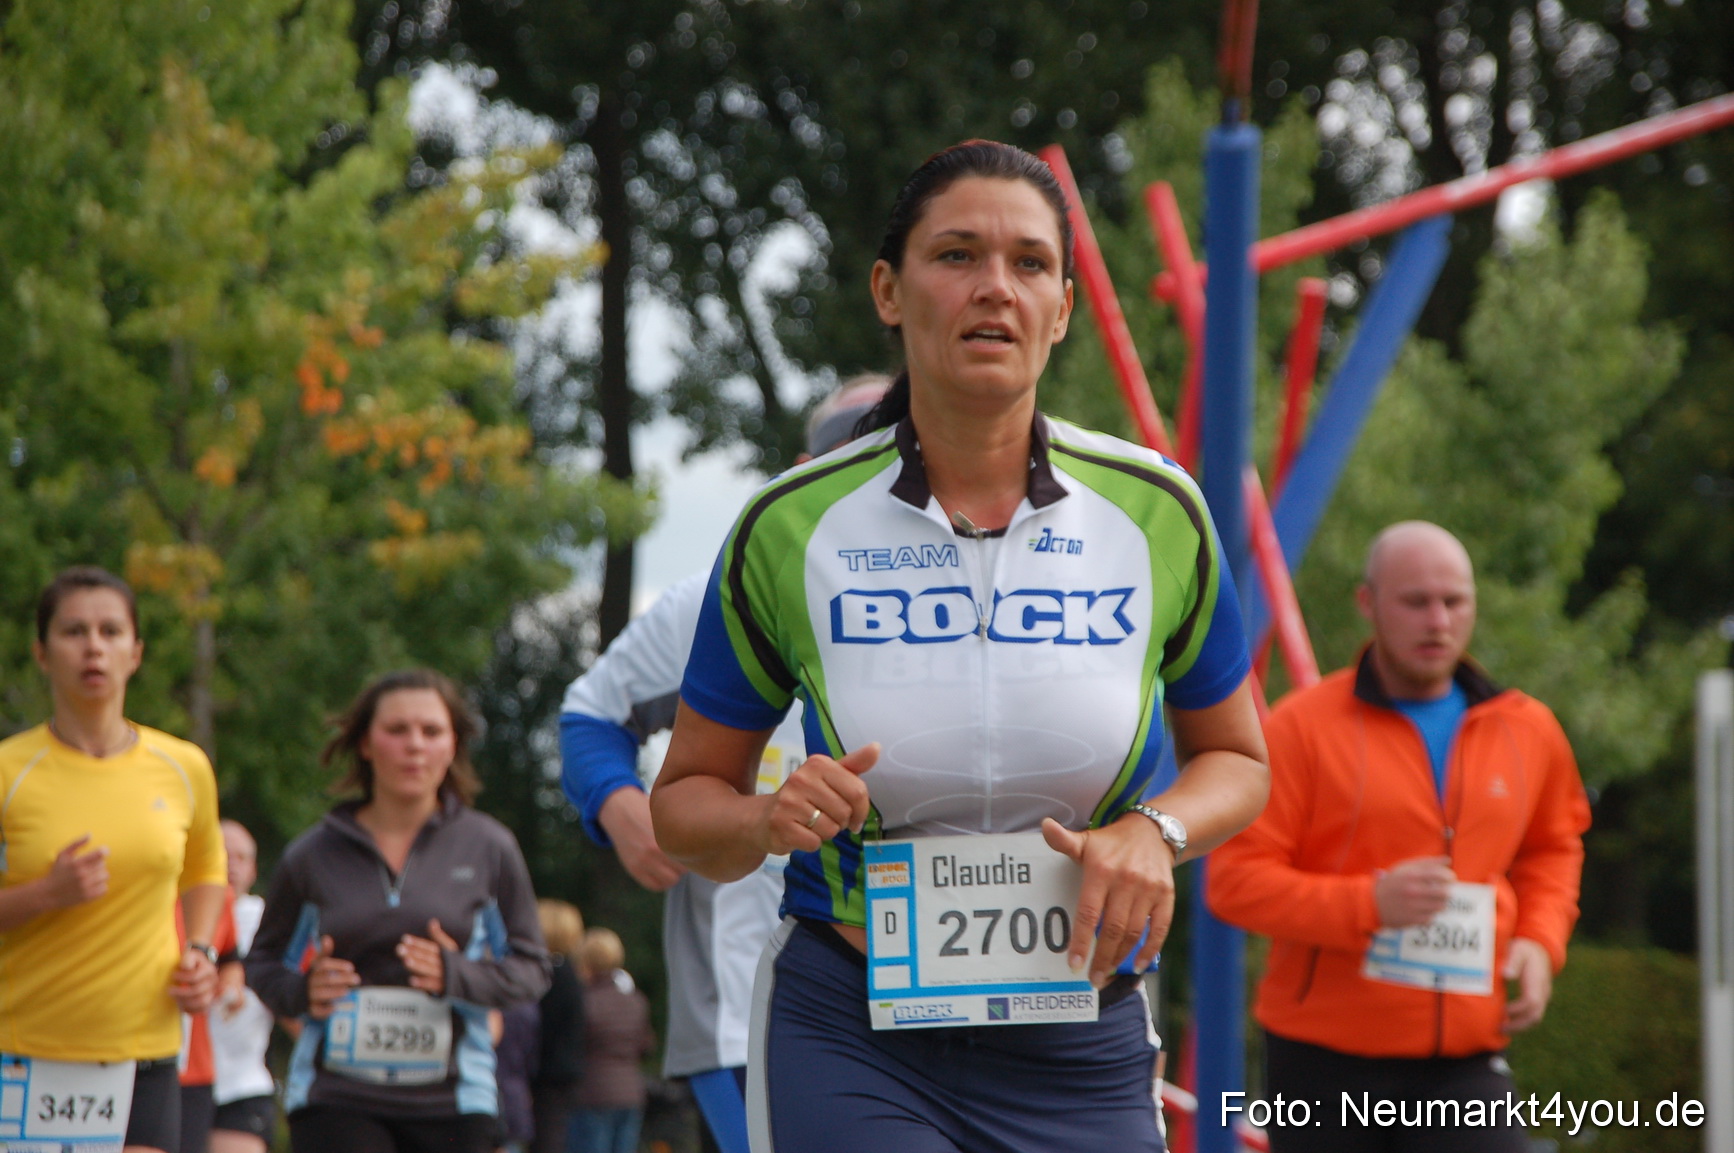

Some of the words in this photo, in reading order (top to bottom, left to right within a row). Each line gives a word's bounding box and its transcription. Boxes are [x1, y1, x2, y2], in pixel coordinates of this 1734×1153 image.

[838, 544, 959, 572] TEAM
[829, 585, 1137, 645] BOCK
[932, 853, 1032, 888] Claudia
[885, 911, 897, 935] D
[938, 906, 1072, 957] 2700
[894, 1003, 955, 1020] BOCK
[1013, 994, 1094, 1011] PFLEIDERER
[366, 1023, 436, 1053] 3299
[38, 1094, 114, 1122] 3474
